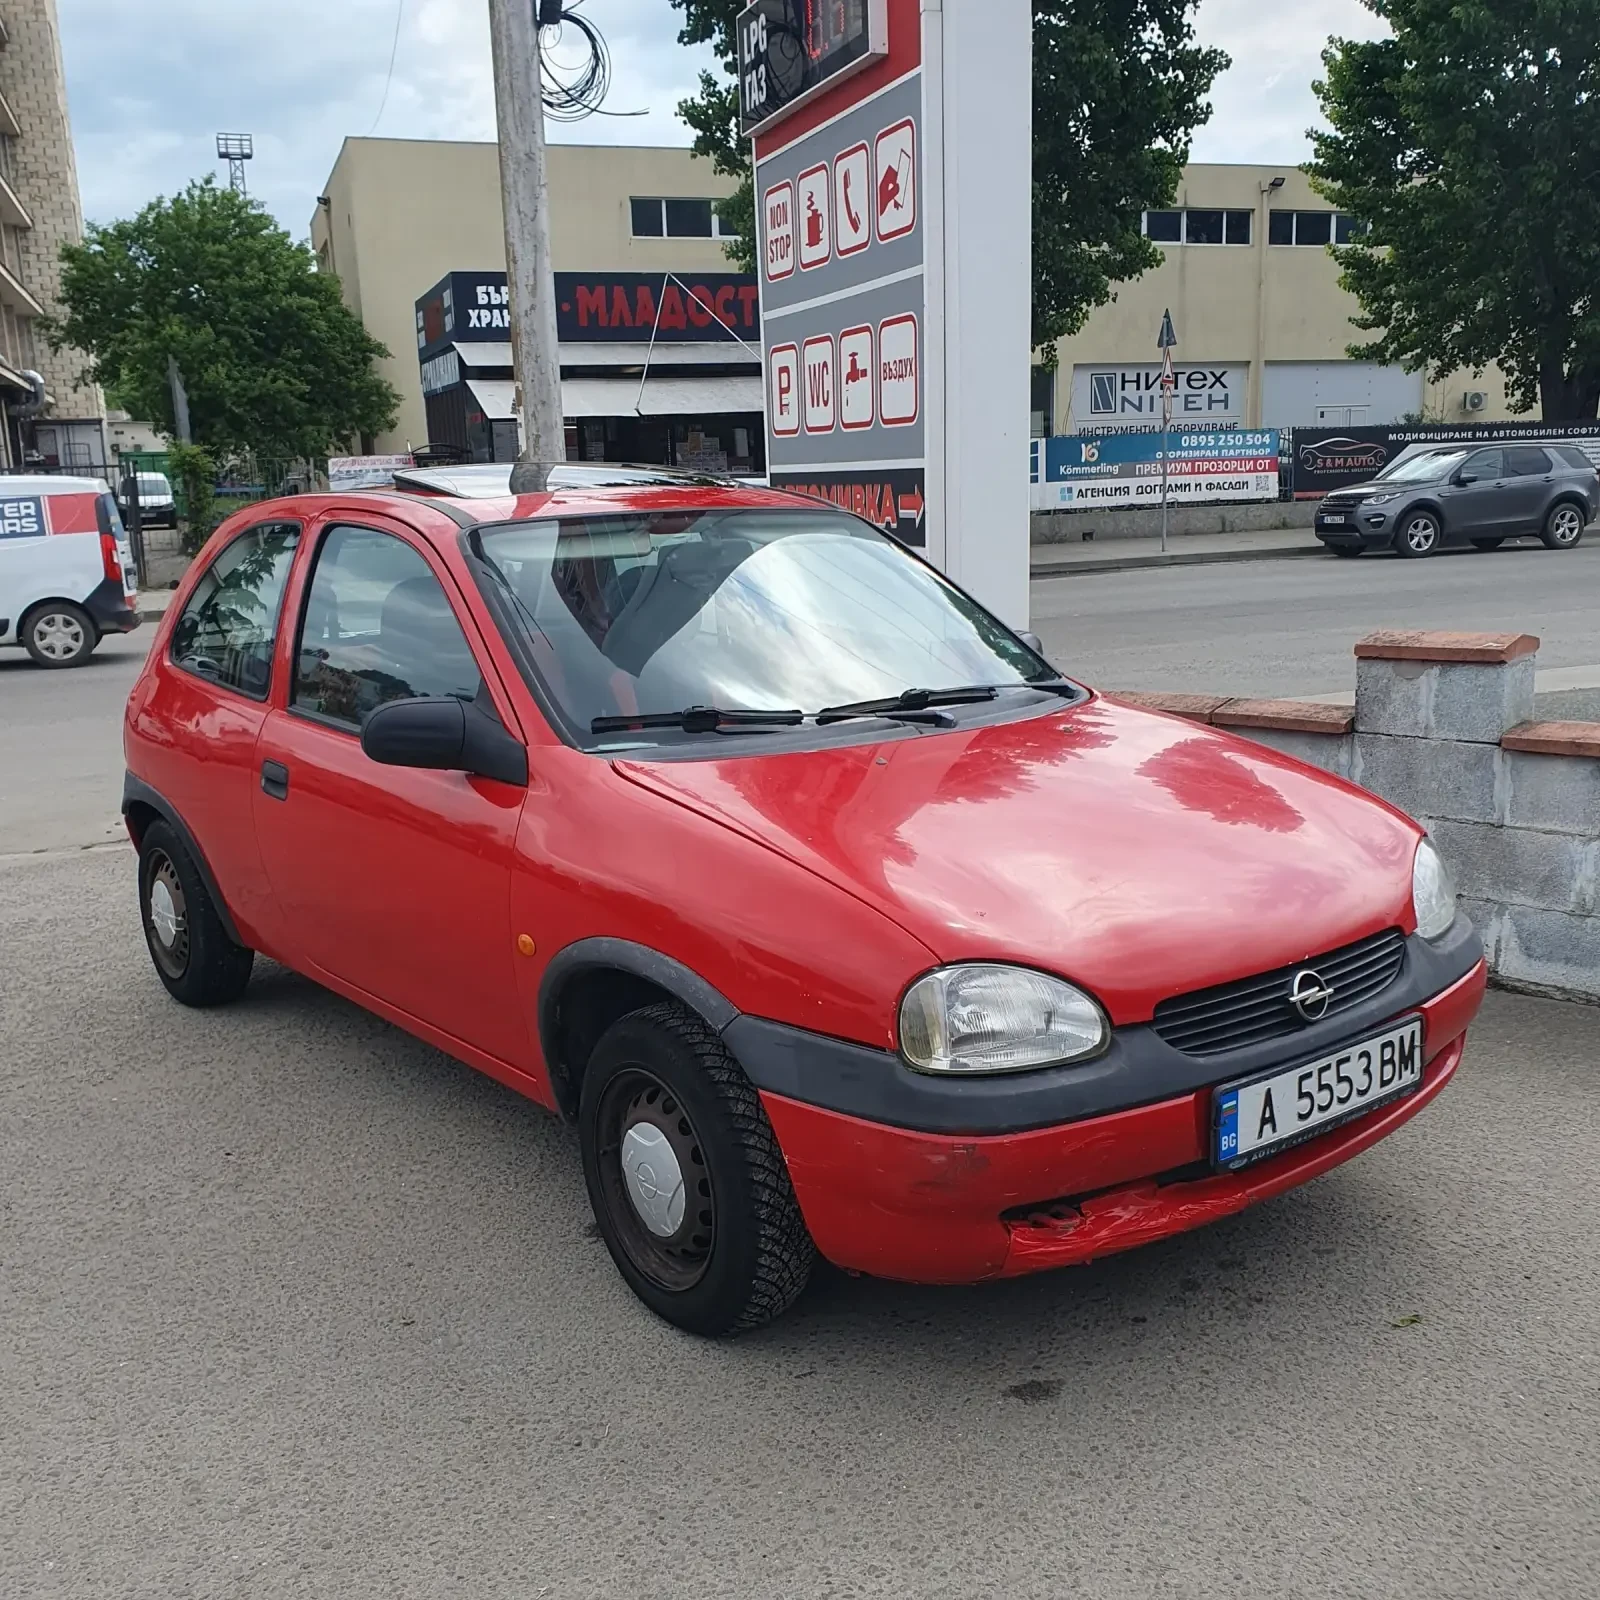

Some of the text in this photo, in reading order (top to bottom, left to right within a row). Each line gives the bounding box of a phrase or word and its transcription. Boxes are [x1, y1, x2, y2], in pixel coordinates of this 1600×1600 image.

[744, 13, 767, 65] LPG
[745, 64, 767, 112] ГАЗ
[770, 200, 788, 230] NON
[769, 234, 791, 264] STOP
[883, 357, 914, 382] ВЪЗДУХ
[808, 361, 830, 408] WC
[1079, 424, 1156, 437] ИНСТРУМЕНТИ
[1181, 433, 1271, 447] 0895 250 504
[1388, 431, 1473, 441] МОДИФИЦИРАНЕ
[1492, 428, 1565, 438] АВТОМОБИЛЕН
[1156, 448, 1271, 458] ООРИЗИРАН ПАРТНЬОР
[1317, 458, 1323, 468] S
[1335, 458, 1344, 467] M
[1347, 456, 1375, 467] AUTO
[1195, 460, 1254, 473] ПРОЗОРЦИ
[1256, 459, 1271, 470] ОТ
[1076, 486, 1130, 499] АГЕНЦИЯ
[1205, 480, 1249, 491] ФАСАДИ
[0, 502, 36, 517] ER
[1256, 1086, 1278, 1140] A
[1296, 1049, 1373, 1121] 5553
[1379, 1030, 1416, 1089] BM
[1221, 1132, 1237, 1151] BG
